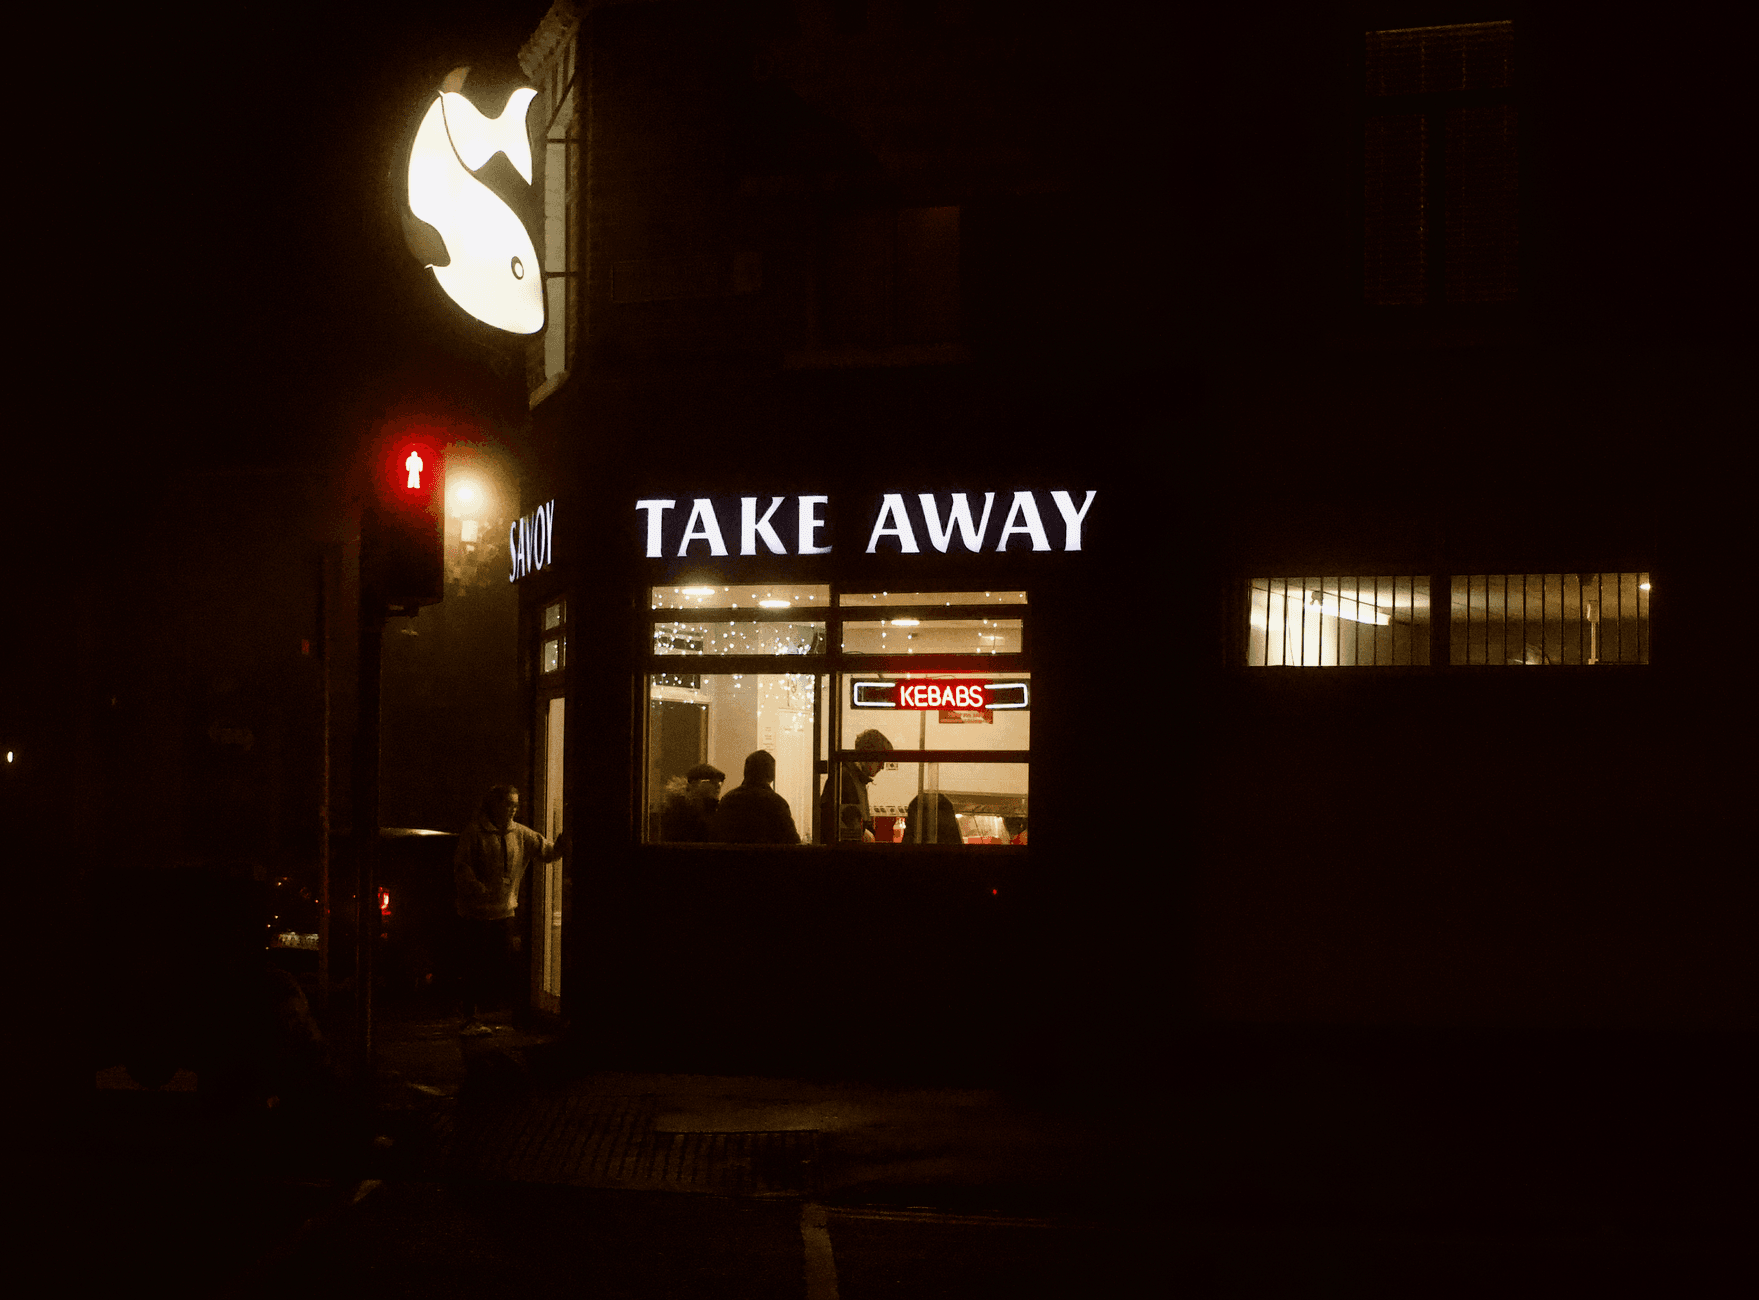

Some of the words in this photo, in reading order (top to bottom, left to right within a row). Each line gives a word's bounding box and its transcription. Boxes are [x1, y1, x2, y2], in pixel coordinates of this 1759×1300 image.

[509, 499, 554, 583] SAVOY
[636, 496, 831, 557] TAKE
[866, 491, 1096, 553] AWAY
[901, 686, 983, 707] KEBABS
